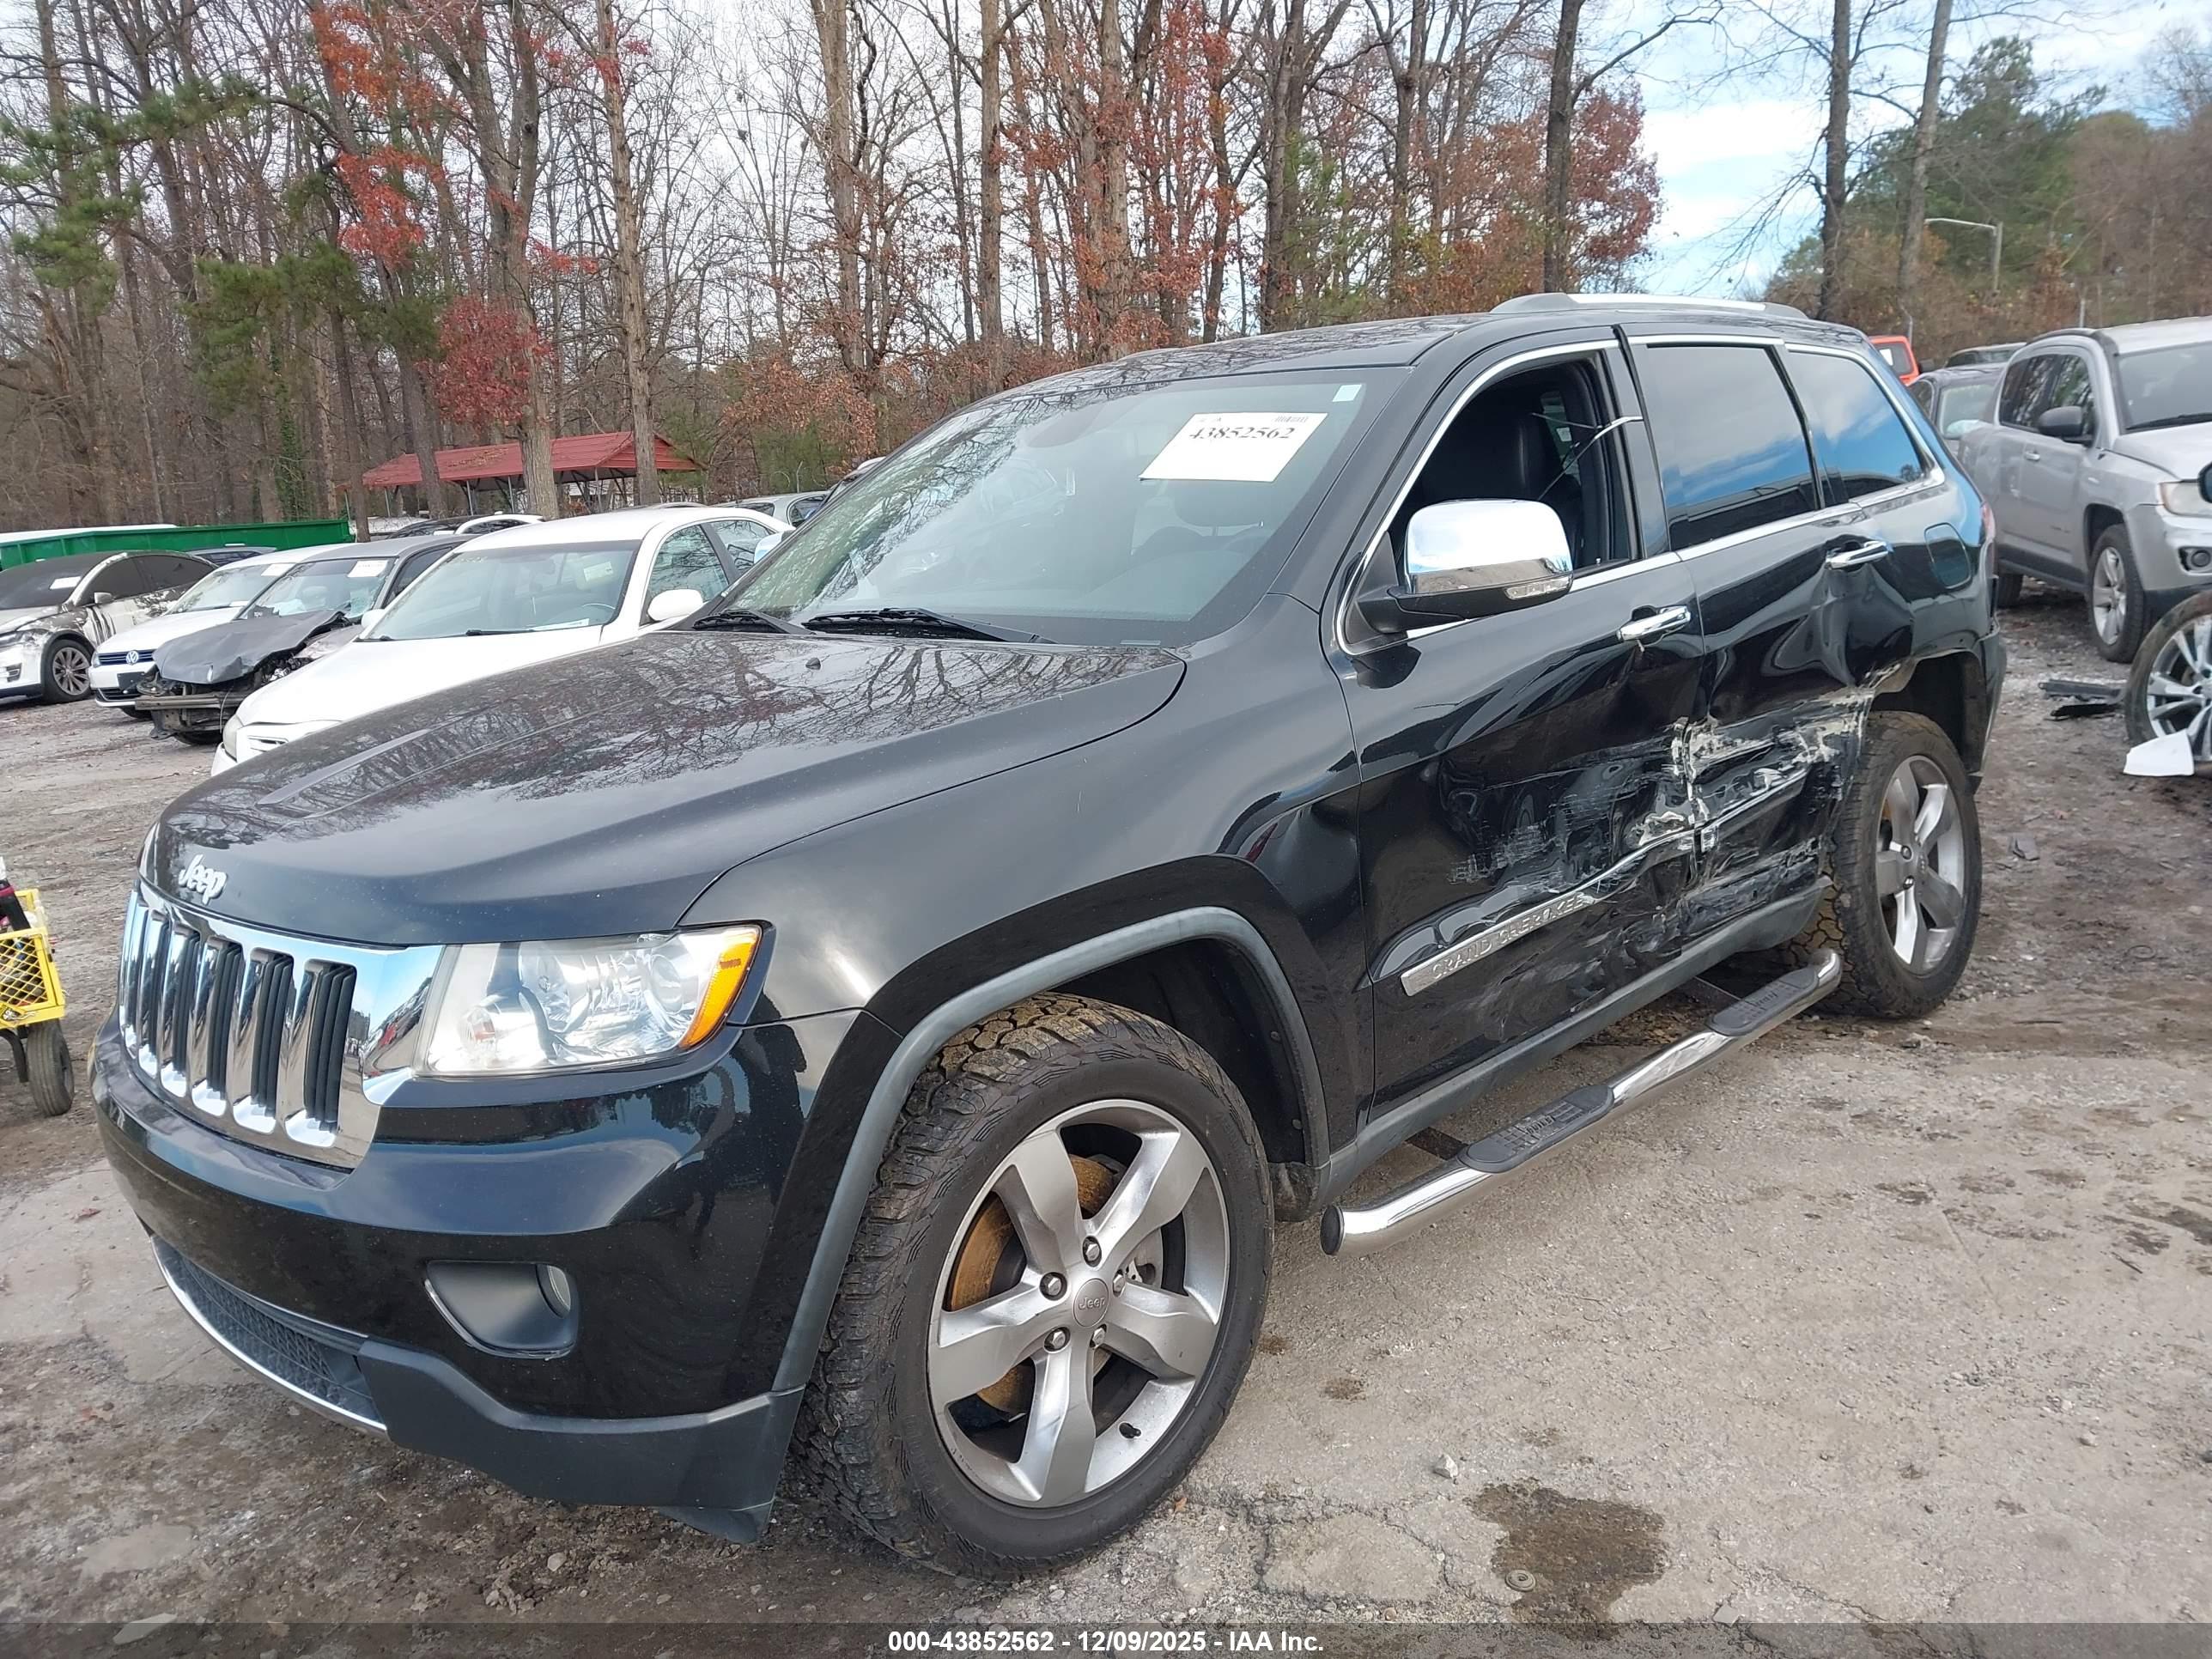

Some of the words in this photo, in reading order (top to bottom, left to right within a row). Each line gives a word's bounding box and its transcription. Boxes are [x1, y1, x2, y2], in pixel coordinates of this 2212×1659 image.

[1189, 427, 1295, 439] 43852562
[178, 854, 228, 905] Jeep
[1431, 936, 1492, 980] GRAND
[1498, 891, 1586, 946] CHEROKEE
[1079, 1297, 1106, 1310] Jeep
